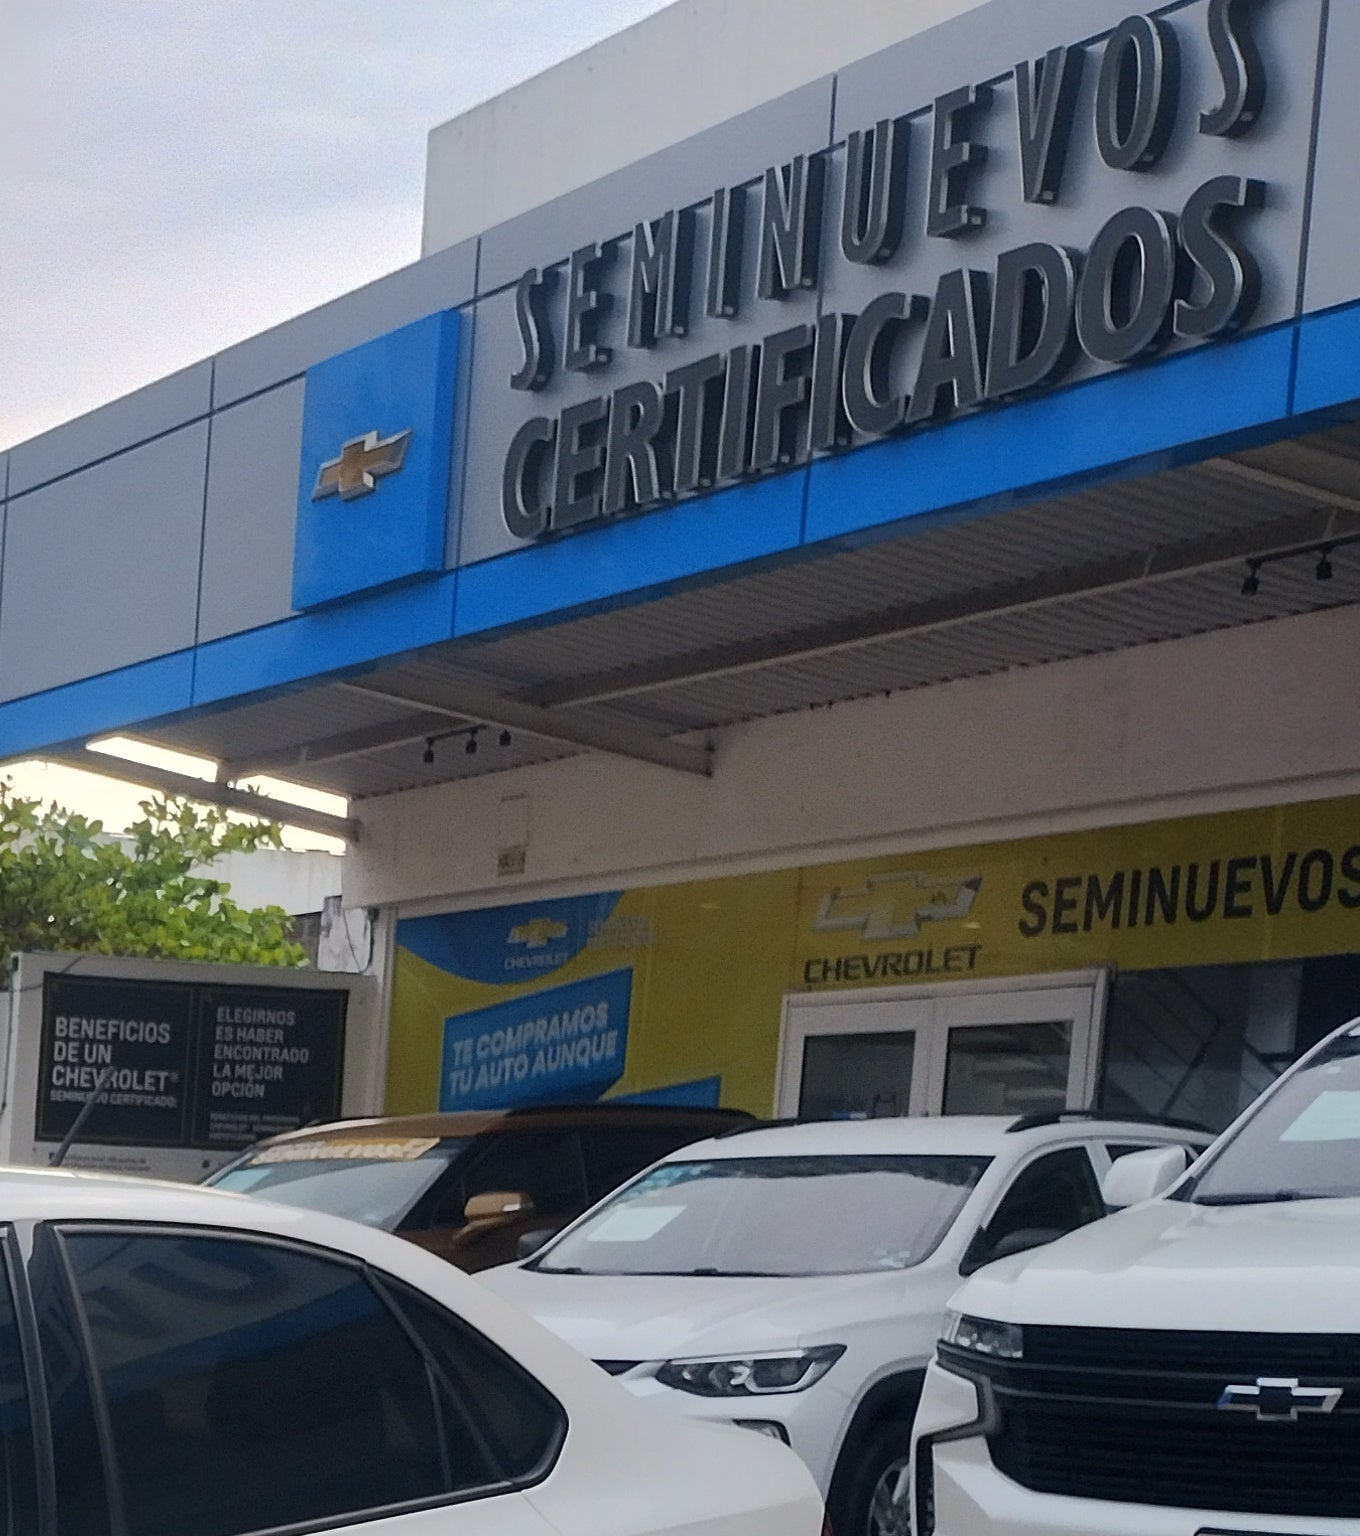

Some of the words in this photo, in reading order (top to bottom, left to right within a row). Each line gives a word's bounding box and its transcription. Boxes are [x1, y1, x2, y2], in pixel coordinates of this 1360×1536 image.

[510, 0, 1265, 391] SEMINUEVOS
[502, 175, 1266, 540] CERTIFICADOS
[1018, 845, 1360, 938] SEMINUEVOS
[803, 943, 981, 985] CHEVROLET
[55, 1016, 171, 1044] BENEFICIOS
[216, 1006, 297, 1026] ELEGIRNOS
[215, 1024, 233, 1042] ES
[236, 1026, 284, 1044] HABER
[452, 1037, 474, 1066] TE
[475, 1001, 609, 1058] COMPRAMOS
[53, 1041, 80, 1063] DE
[84, 1043, 112, 1064] UN
[214, 1043, 310, 1064] ENCONTRADO
[449, 1069, 473, 1096] TU
[473, 1053, 529, 1091] AUTO
[532, 1029, 618, 1073] AUNQUE
[213, 1062, 232, 1079] LA
[234, 1064, 283, 1080] MEJOR
[211, 1079, 265, 1098] OPCIÓN
